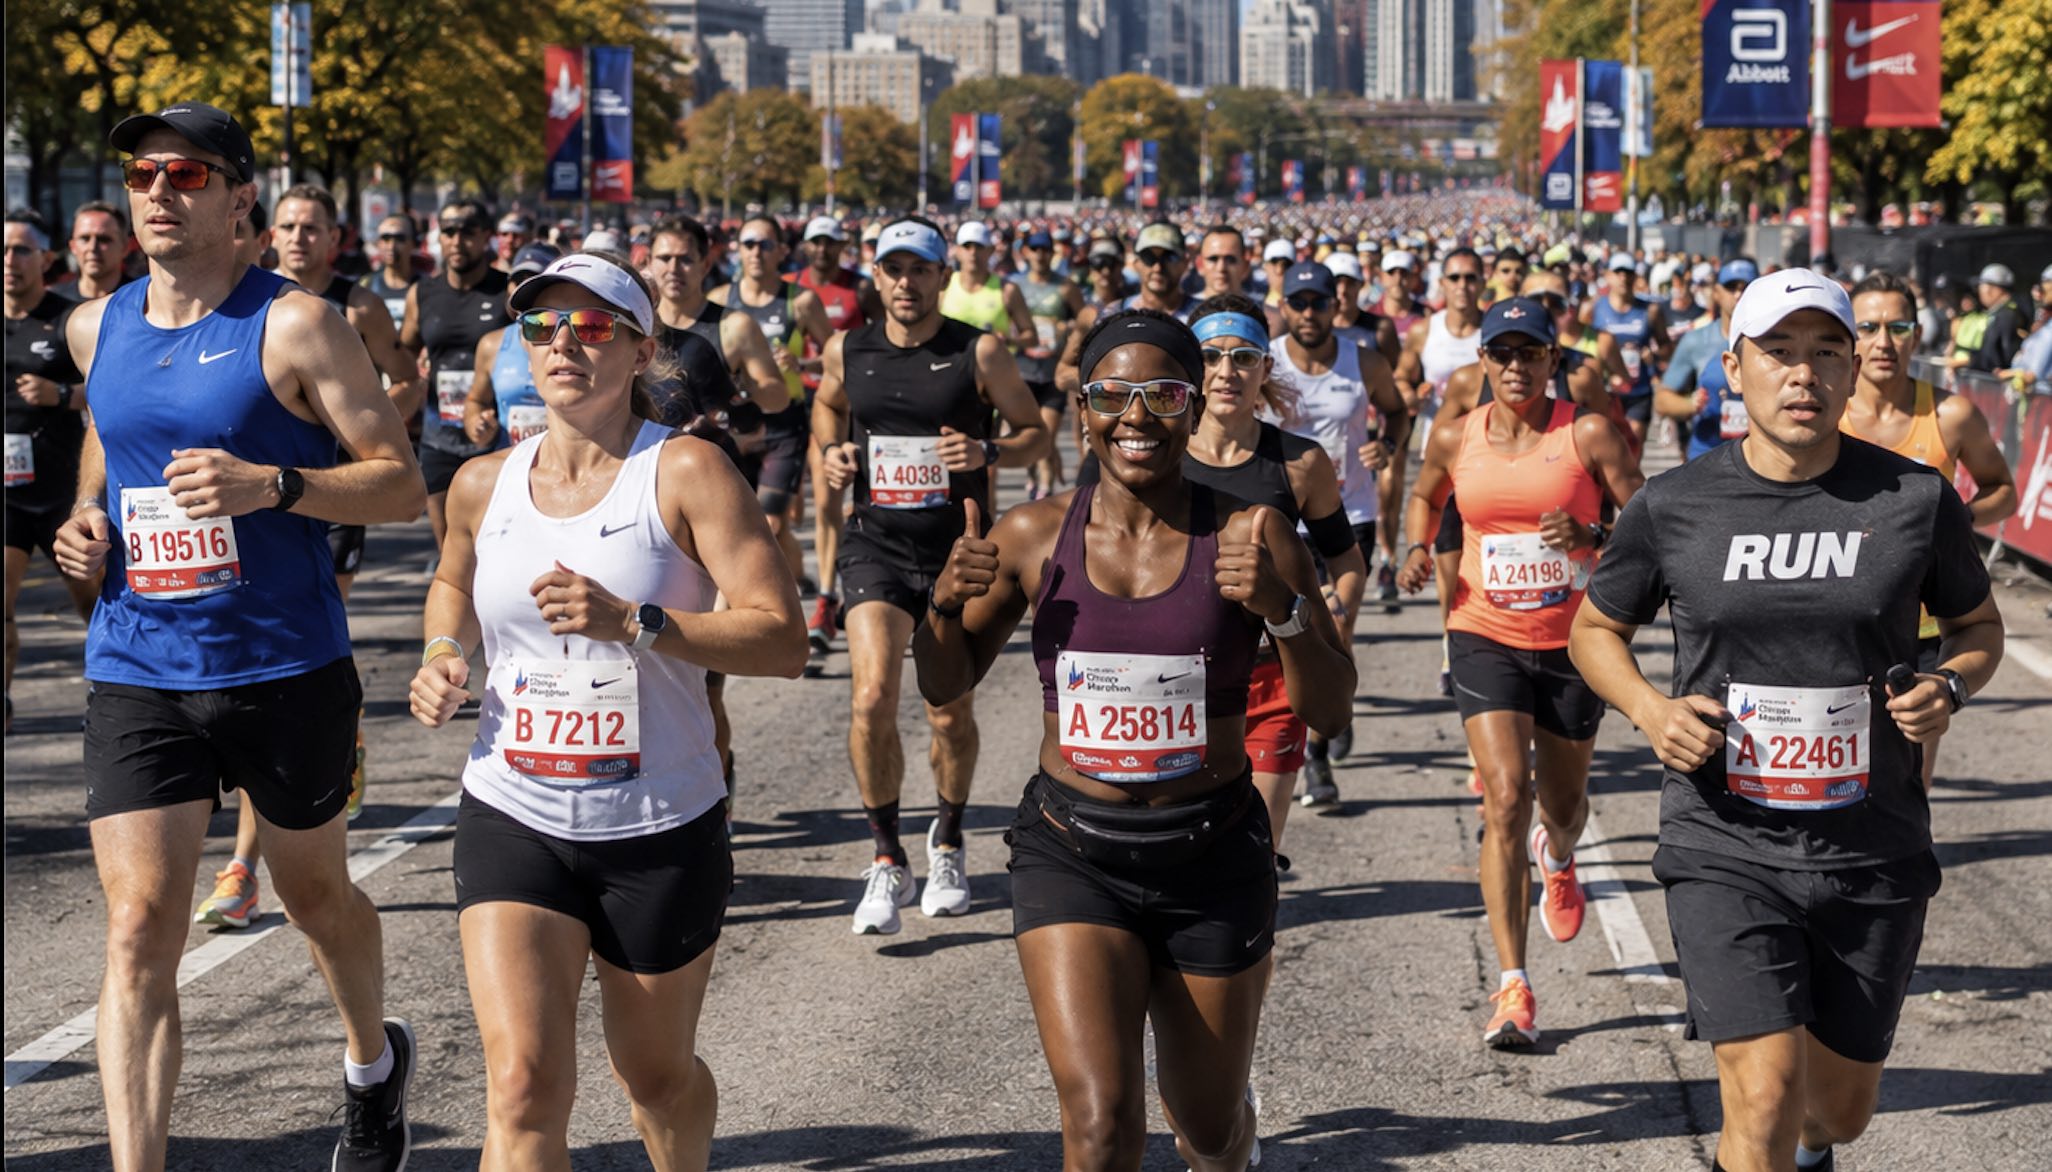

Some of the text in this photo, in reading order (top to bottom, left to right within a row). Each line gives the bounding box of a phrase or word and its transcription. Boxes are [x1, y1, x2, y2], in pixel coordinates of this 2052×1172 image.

[1725, 62, 1791, 83] Abbott
[876, 464, 943, 486] A 4038
[130, 527, 229, 562] B 19516
[1723, 531, 1862, 582] RUN
[1488, 560, 1564, 585] A 24198
[515, 708, 626, 746] B 7212
[1068, 702, 1197, 742] A 25814
[1735, 733, 1859, 769] A 22461
